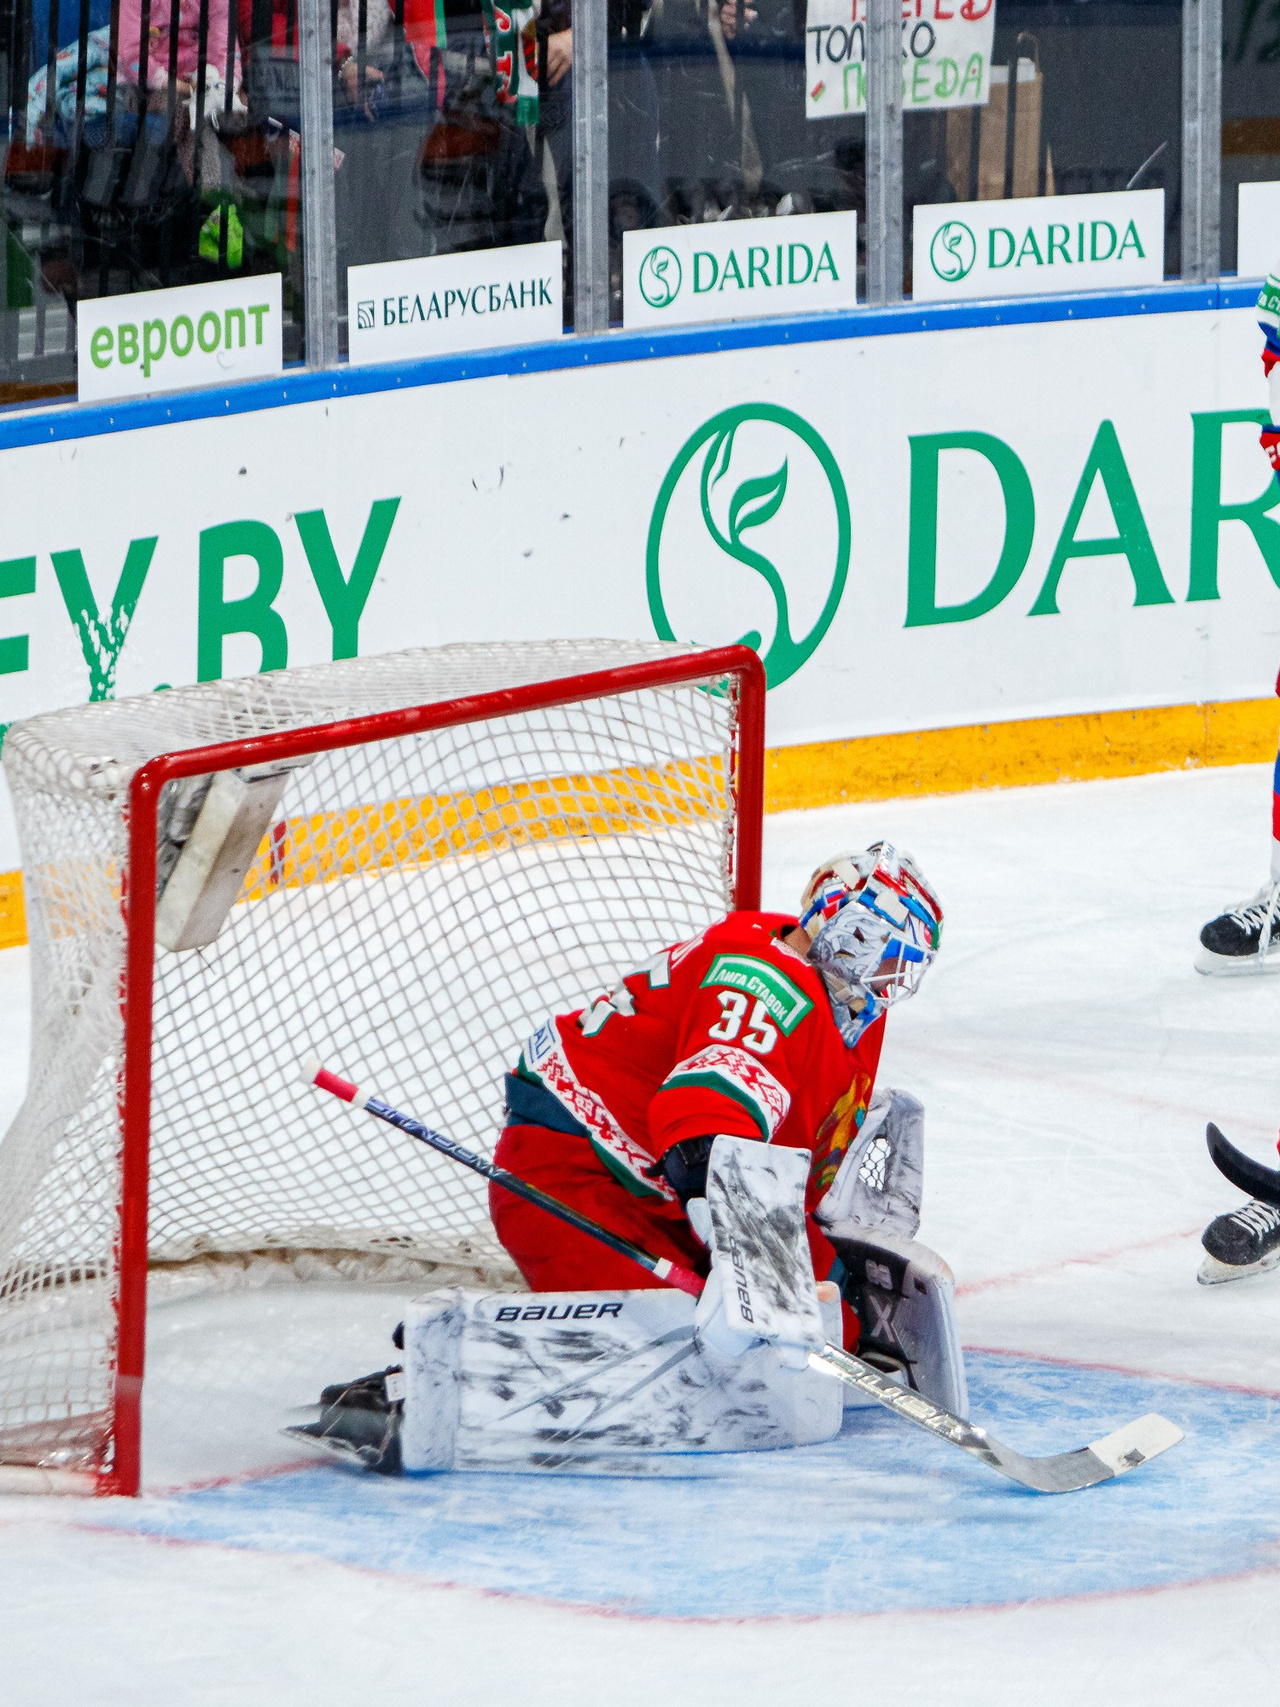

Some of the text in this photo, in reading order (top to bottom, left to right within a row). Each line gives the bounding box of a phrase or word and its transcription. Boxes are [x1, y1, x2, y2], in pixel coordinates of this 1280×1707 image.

[806, 22, 936, 63] ТОЛО
[843, 52, 983, 109] ПЕДА
[692, 241, 839, 293] DARIDA
[988, 219, 1146, 269] DARIDA
[384, 277, 553, 326] БЕЛАРУСБАНК
[90, 303, 270, 377] евроопт
[708, 989, 778, 1055] 35
[495, 1301, 624, 1323] BAUER
